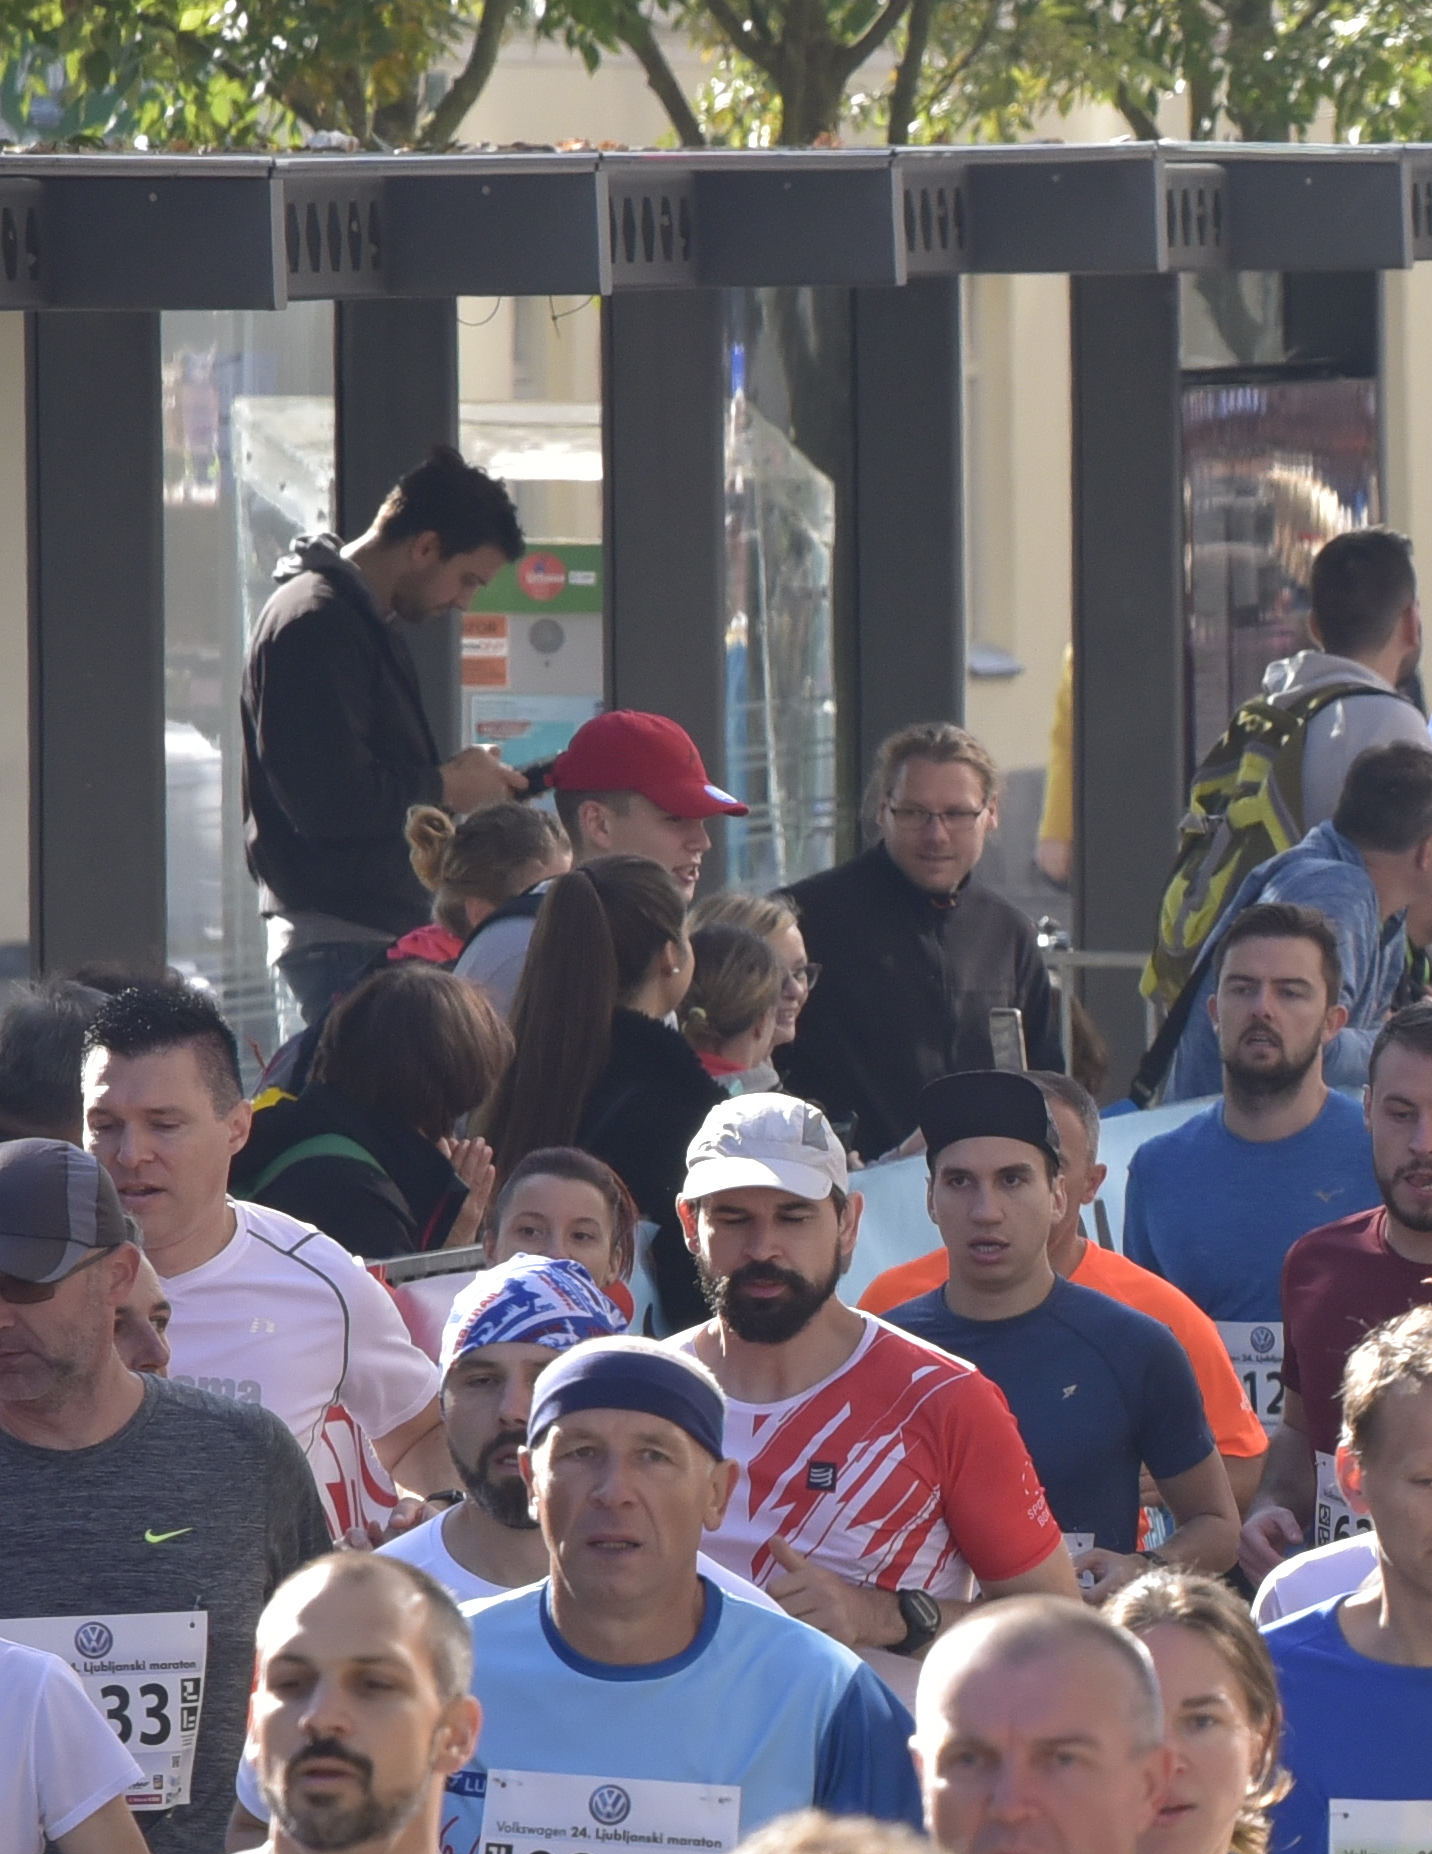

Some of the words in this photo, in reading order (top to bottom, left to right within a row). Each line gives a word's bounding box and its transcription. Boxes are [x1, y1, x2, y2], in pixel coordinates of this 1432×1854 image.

[85, 1659, 150, 1675] Ljubljanski
[152, 1660, 197, 1671] maraton
[497, 1820, 568, 1839] Volkswagen
[571, 1825, 591, 1840] 24.
[594, 1826, 665, 1848] Ljubljanski
[667, 1836, 723, 1850] maraton
